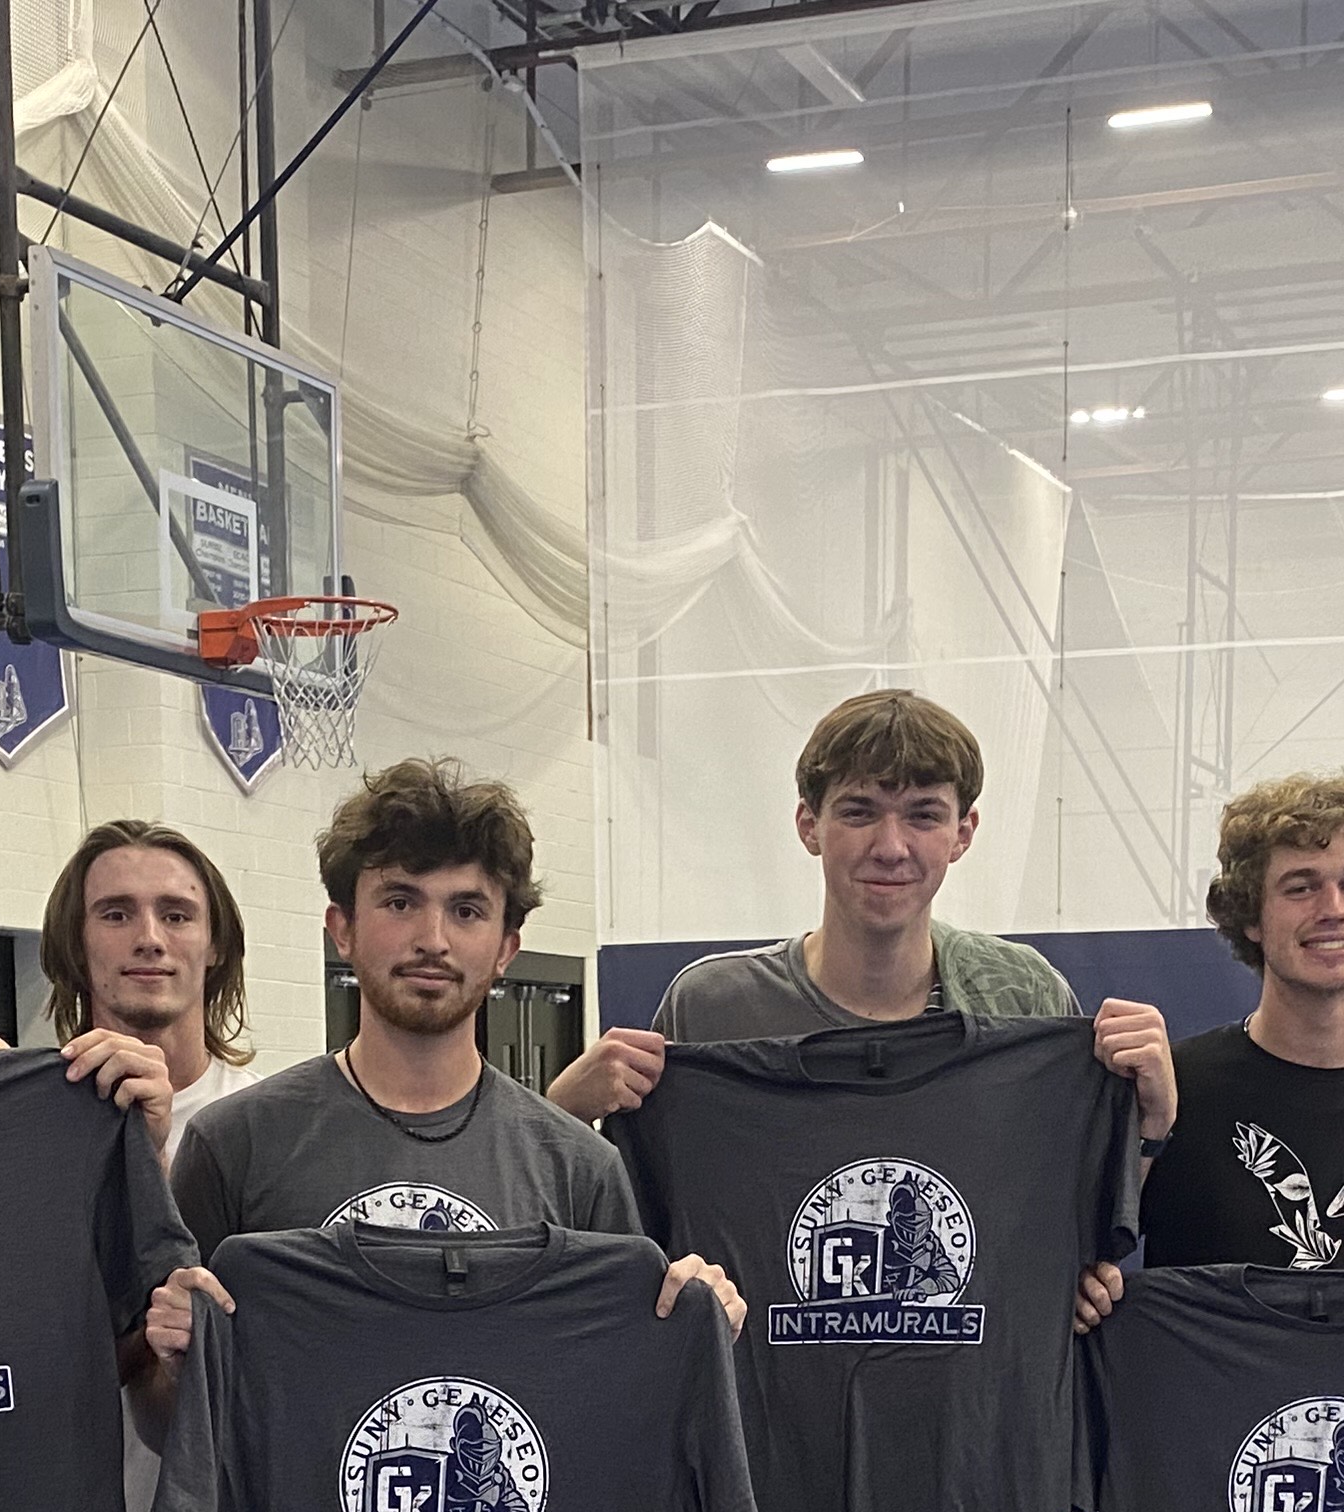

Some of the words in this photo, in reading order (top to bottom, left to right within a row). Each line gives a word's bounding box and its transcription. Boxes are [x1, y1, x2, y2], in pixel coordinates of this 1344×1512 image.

[389, 1192, 488, 1232] GENE
[794, 1177, 844, 1251] SUNY
[861, 1167, 967, 1248] GENESEO
[774, 1310, 979, 1336] INTRAMURALS
[347, 1400, 402, 1481] SUNY
[422, 1388, 539, 1482] GENESEO
[1236, 1416, 1287, 1487] SUNY
